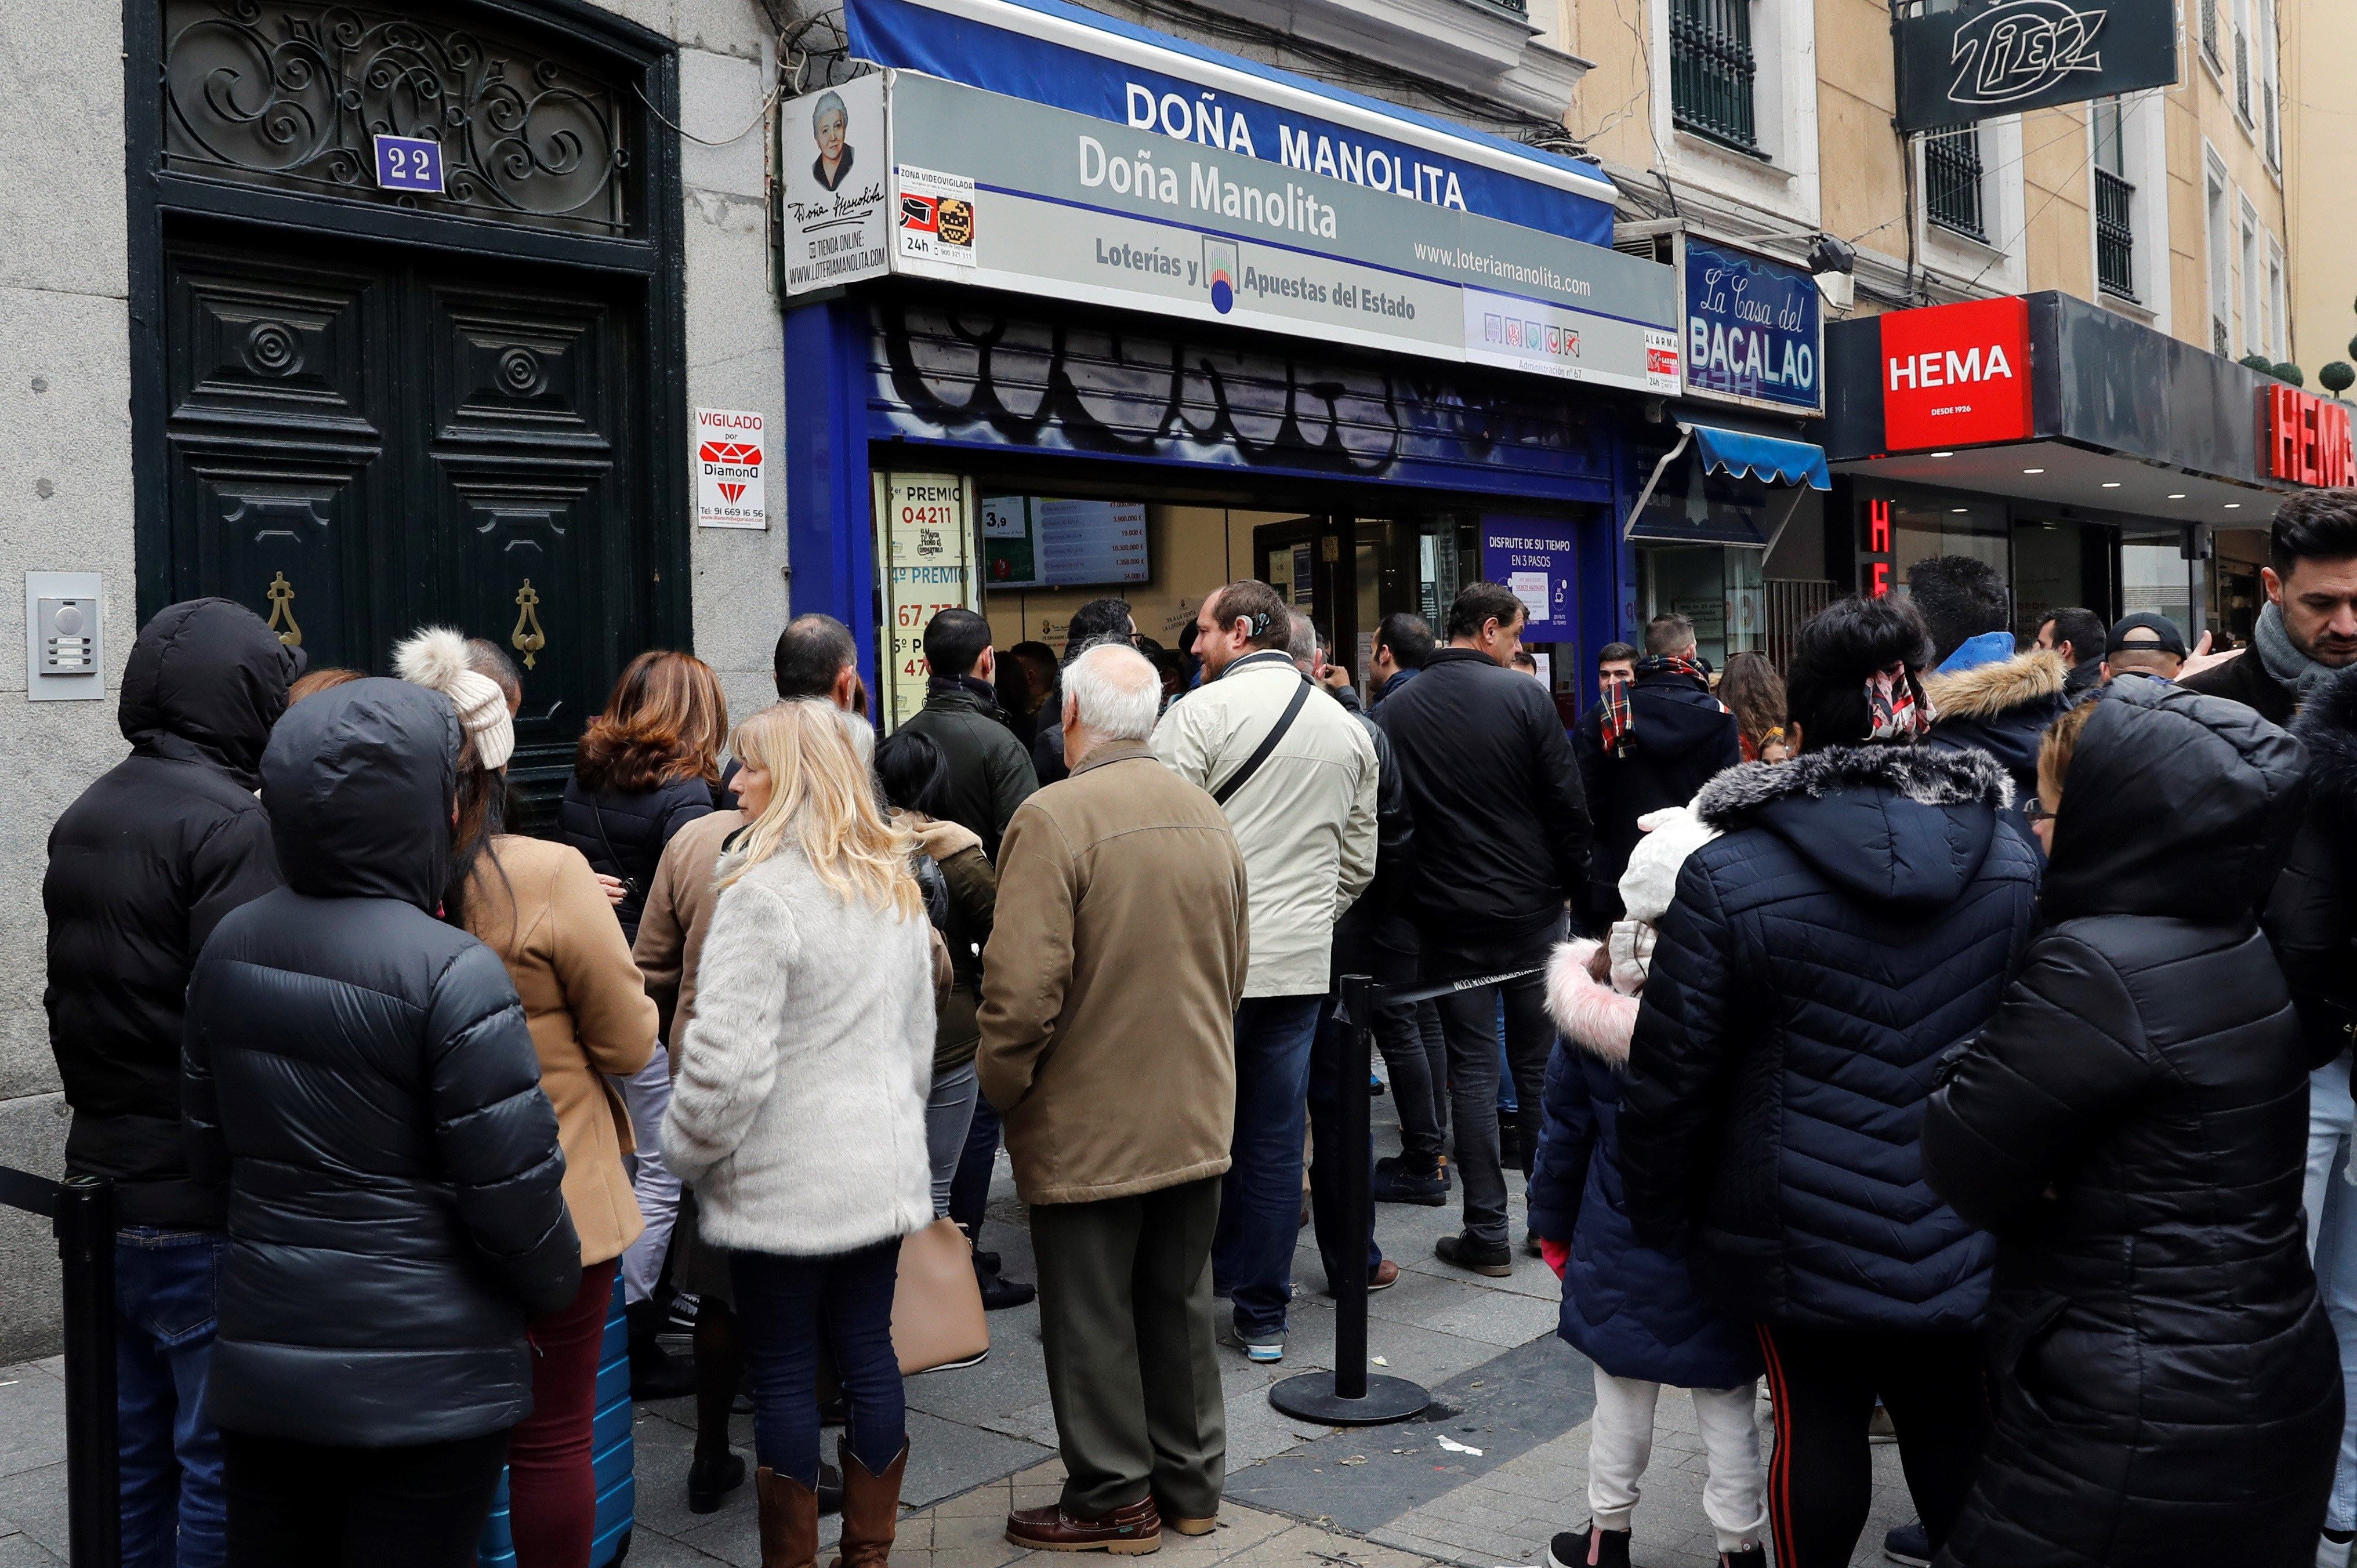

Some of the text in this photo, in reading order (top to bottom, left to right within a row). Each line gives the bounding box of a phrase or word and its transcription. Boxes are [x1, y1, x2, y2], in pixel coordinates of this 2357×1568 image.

[1126, 82, 1467, 212] DOÑA MANOLITA
[388, 147, 430, 180] 22
[901, 169, 920, 180] ZONA
[922, 173, 973, 190] VIDEOVIGILADA
[1079, 135, 1337, 239] Doña Manolita
[788, 203, 829, 223] Doña
[818, 230, 864, 257] TIENDA ONLINE:
[907, 237, 929, 252] 24h
[789, 247, 885, 285] WWW.LOTERIAMANOLITA.COM
[1414, 242, 1590, 296] www.loteriamanolita.com
[1096, 238, 1415, 320] Loterías y Apuestas del Estado
[1700, 268, 1803, 333] La Casa del
[1646, 335, 1677, 348] ALARMA
[1690, 315, 1813, 390] BACALAO
[1519, 359, 1565, 377] Administración
[1574, 369, 1582, 379] 67
[1890, 344, 2012, 391] HEMA
[1650, 377, 1659, 386] 24h
[698, 411, 763, 430] VIGILADO
[1931, 405, 1971, 416] DESDE 1926
[2270, 383, 2357, 488] HEMA
[907, 487, 961, 502] PREMIO
[725, 508, 741, 516] 669
[743, 509, 750, 517] 16
[753, 509, 764, 517] 56
[902, 506, 951, 524] 04211
[986, 512, 1007, 528] 3,9
[1489, 536, 1570, 551] DISFRUTE DE SU TIEMPO
[1512, 555, 1551, 567] EN 3 PASOS
[912, 567, 969, 584] PREMIO
